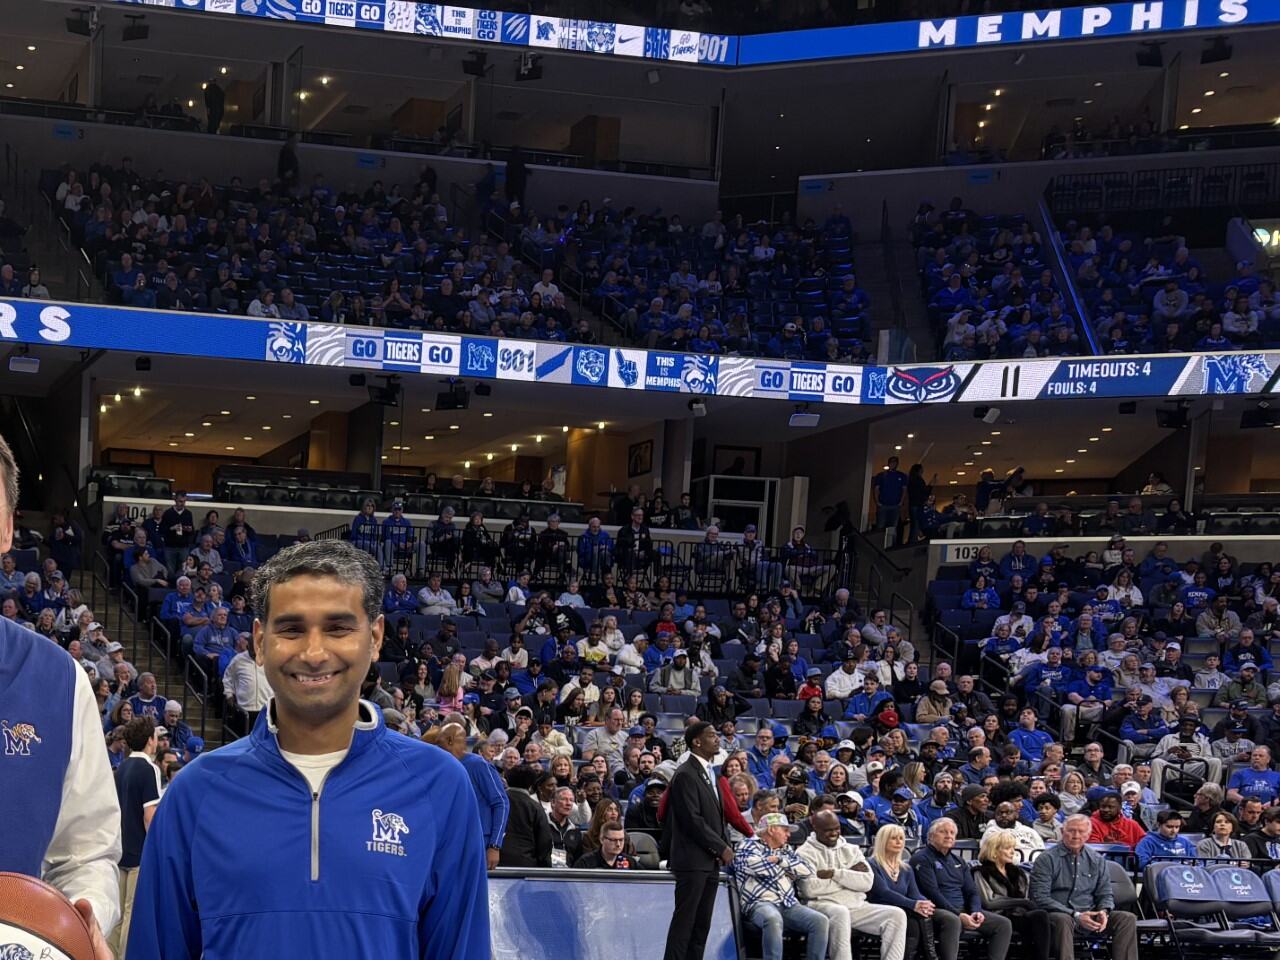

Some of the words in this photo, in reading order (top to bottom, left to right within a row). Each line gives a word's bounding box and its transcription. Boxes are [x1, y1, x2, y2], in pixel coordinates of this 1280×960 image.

[329, 2, 354, 17] TIGERS
[361, 6, 380, 20] GO
[452, 10, 466, 18] THIS
[479, 10, 496, 20] GO
[444, 26, 471, 35] MEMPHIS
[477, 19, 497, 31] TIGERS
[918, 0, 1248, 47] MEMPHIS
[477, 30, 495, 40] GO
[558, 27, 588, 40] MEM
[699, 35, 728, 62] 901
[352, 339, 377, 357] GO
[387, 341, 419, 361] TIGERS
[429, 345, 452, 364] GO
[499, 347, 534, 373] 901
[656, 356, 675, 367] THIS
[660, 367, 668, 376] IS
[1068, 362, 1142, 378] TIMEOUTS:
[1143, 361, 1151, 376] 4
[647, 375, 681, 388] MEMPHIS
[761, 371, 784, 389] GO
[792, 372, 822, 391] TIGERS
[832, 375, 854, 393] GO
[1047, 381, 1087, 395] FOULS:
[1089, 382, 1097, 394] 4
[955, 546, 979, 560] 103
[366, 840, 405, 857] TIGERS
